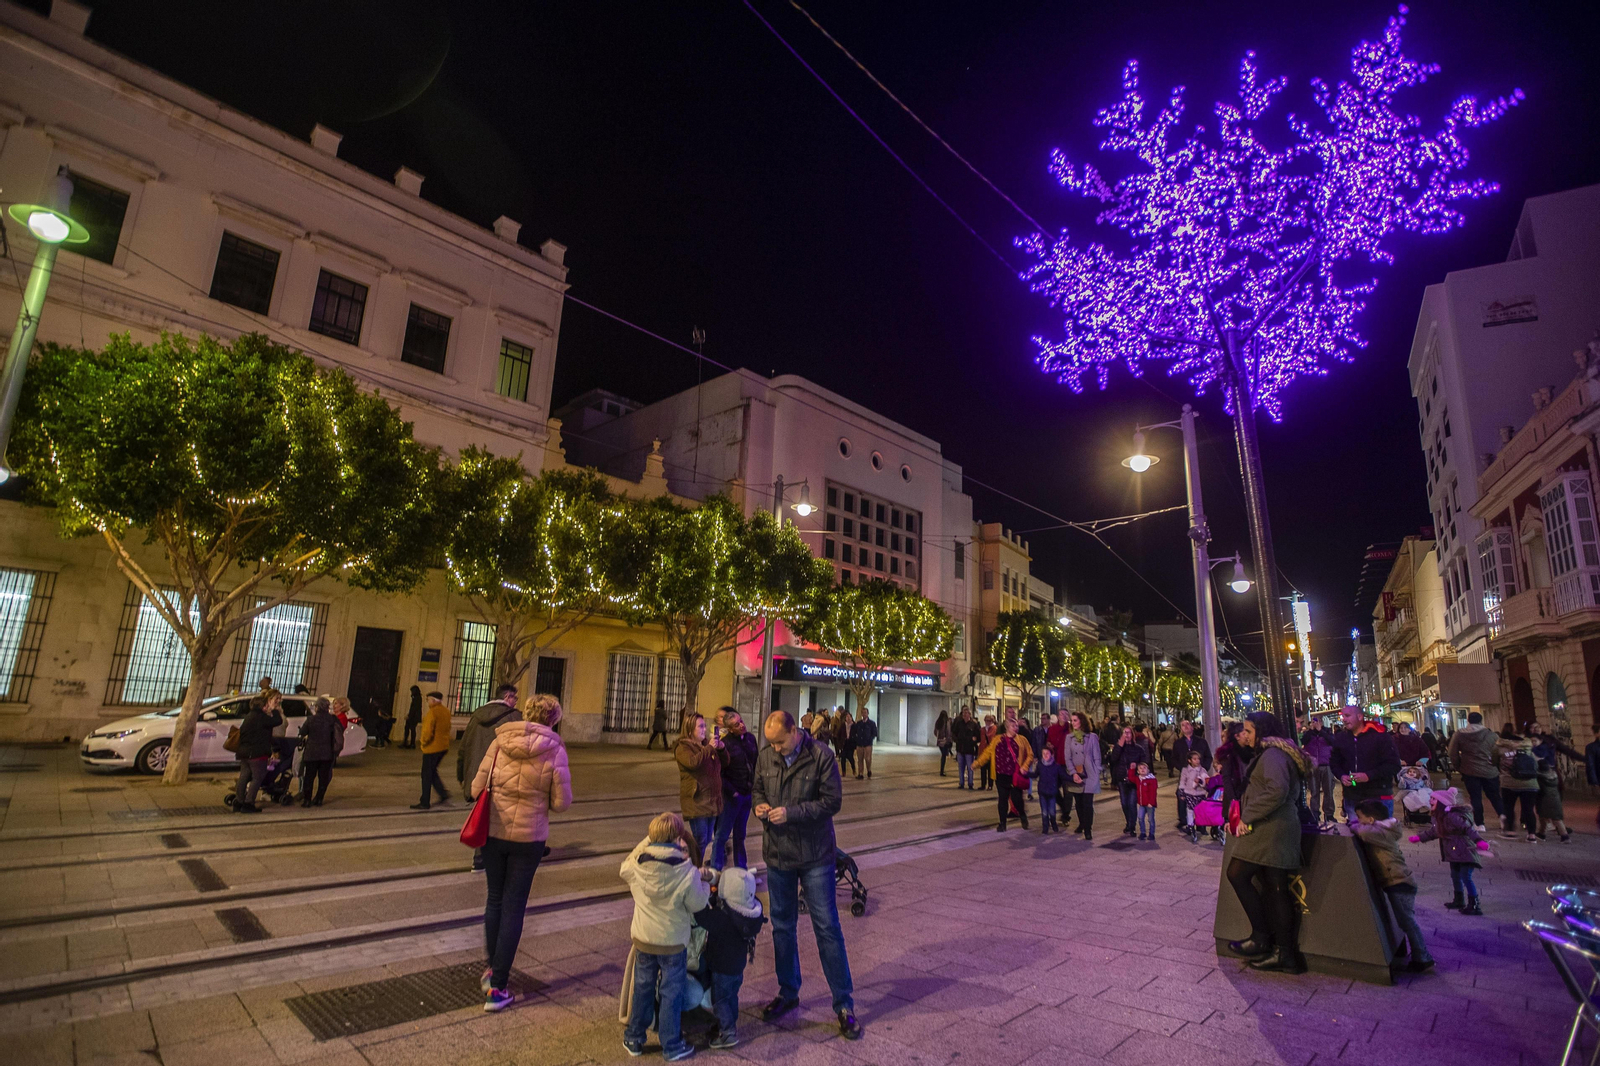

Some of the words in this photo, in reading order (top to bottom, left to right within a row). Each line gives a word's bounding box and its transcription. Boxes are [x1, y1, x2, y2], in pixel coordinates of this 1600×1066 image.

[802, 664, 822, 676] Centro
[823, 666, 831, 676] de
[881, 672, 888, 682] de
[888, 672, 894, 682] la
[895, 674, 905, 683] Real
[906, 674, 914, 684] Isla
[914, 675, 921, 685] de
[921, 676, 933, 686] León
